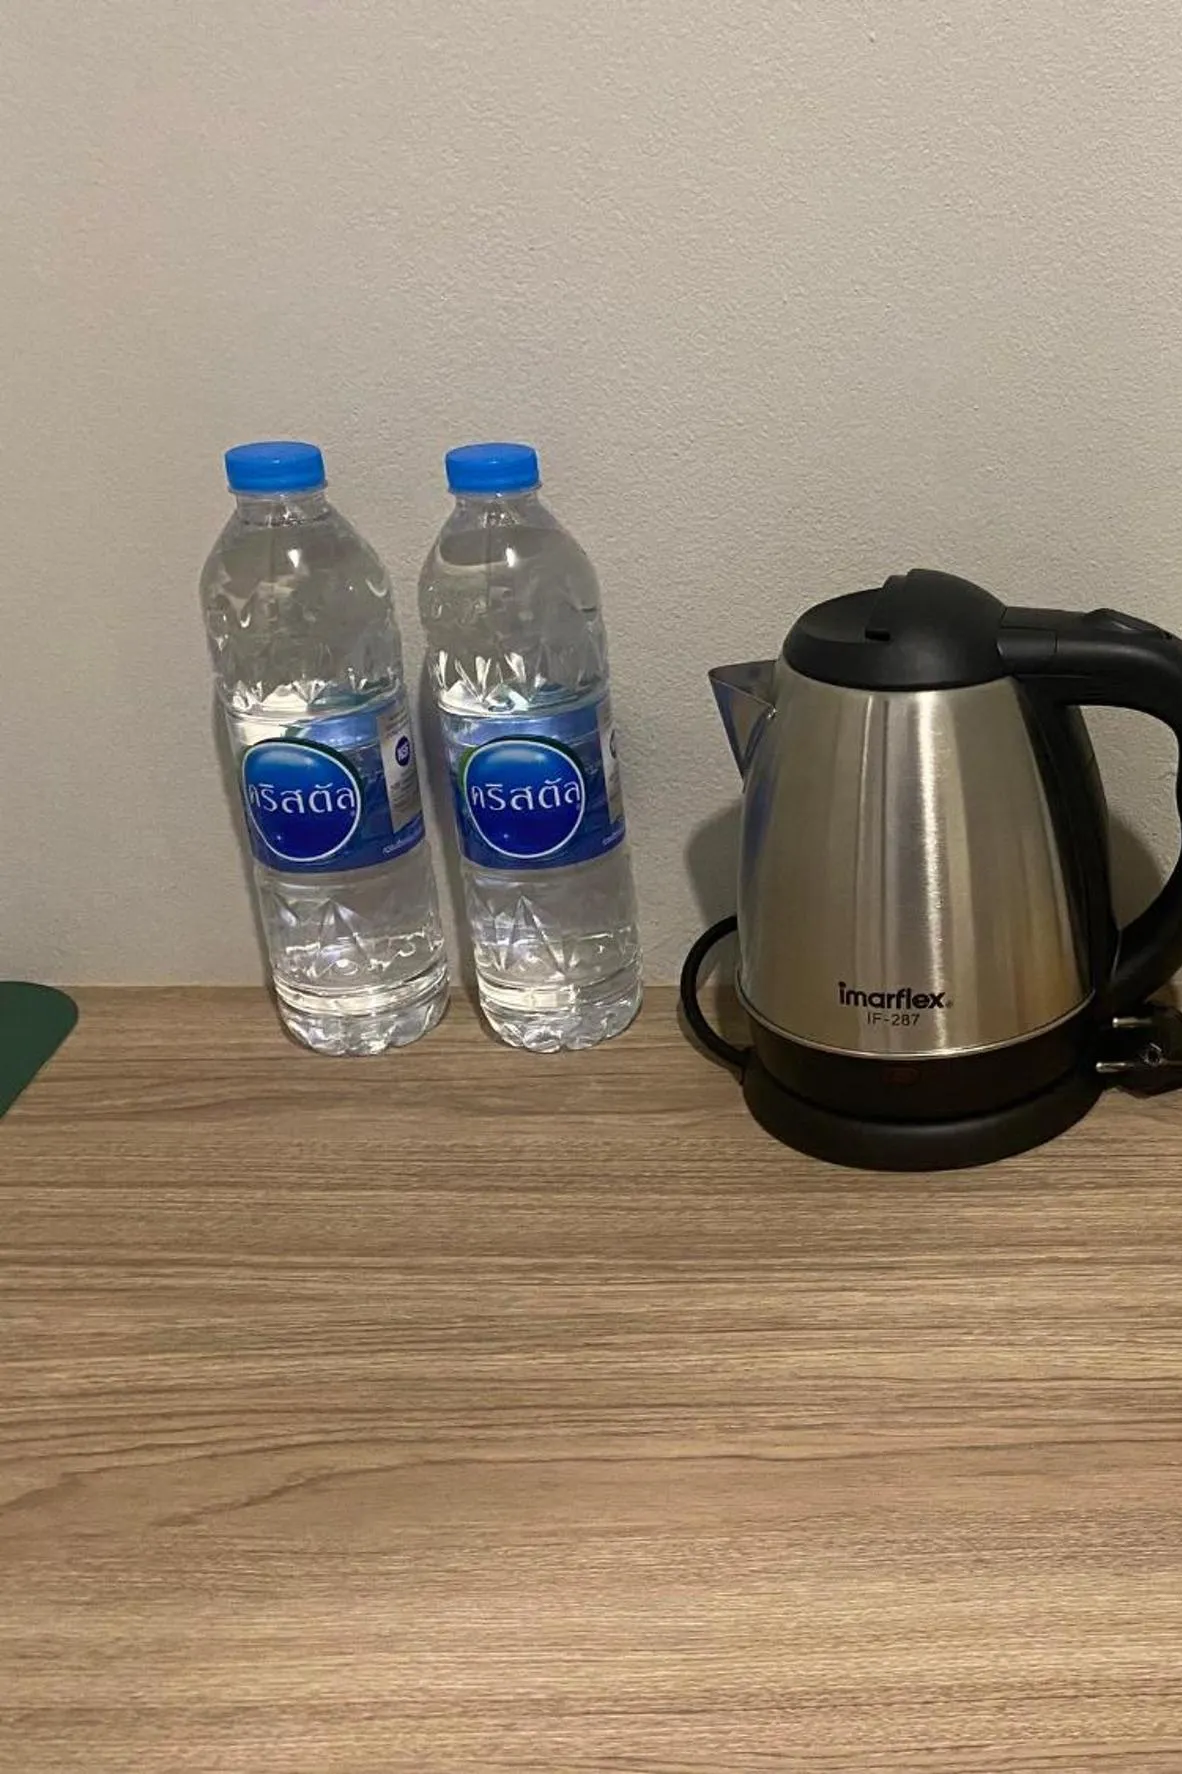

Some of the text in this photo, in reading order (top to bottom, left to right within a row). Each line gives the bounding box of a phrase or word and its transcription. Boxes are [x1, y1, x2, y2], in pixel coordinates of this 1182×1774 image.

[248, 782, 355, 814] คริสตัล
[471, 777, 580, 811] คริสตัล
[838, 981, 946, 1010] imarflex
[866, 1012, 921, 1027] IF-287
